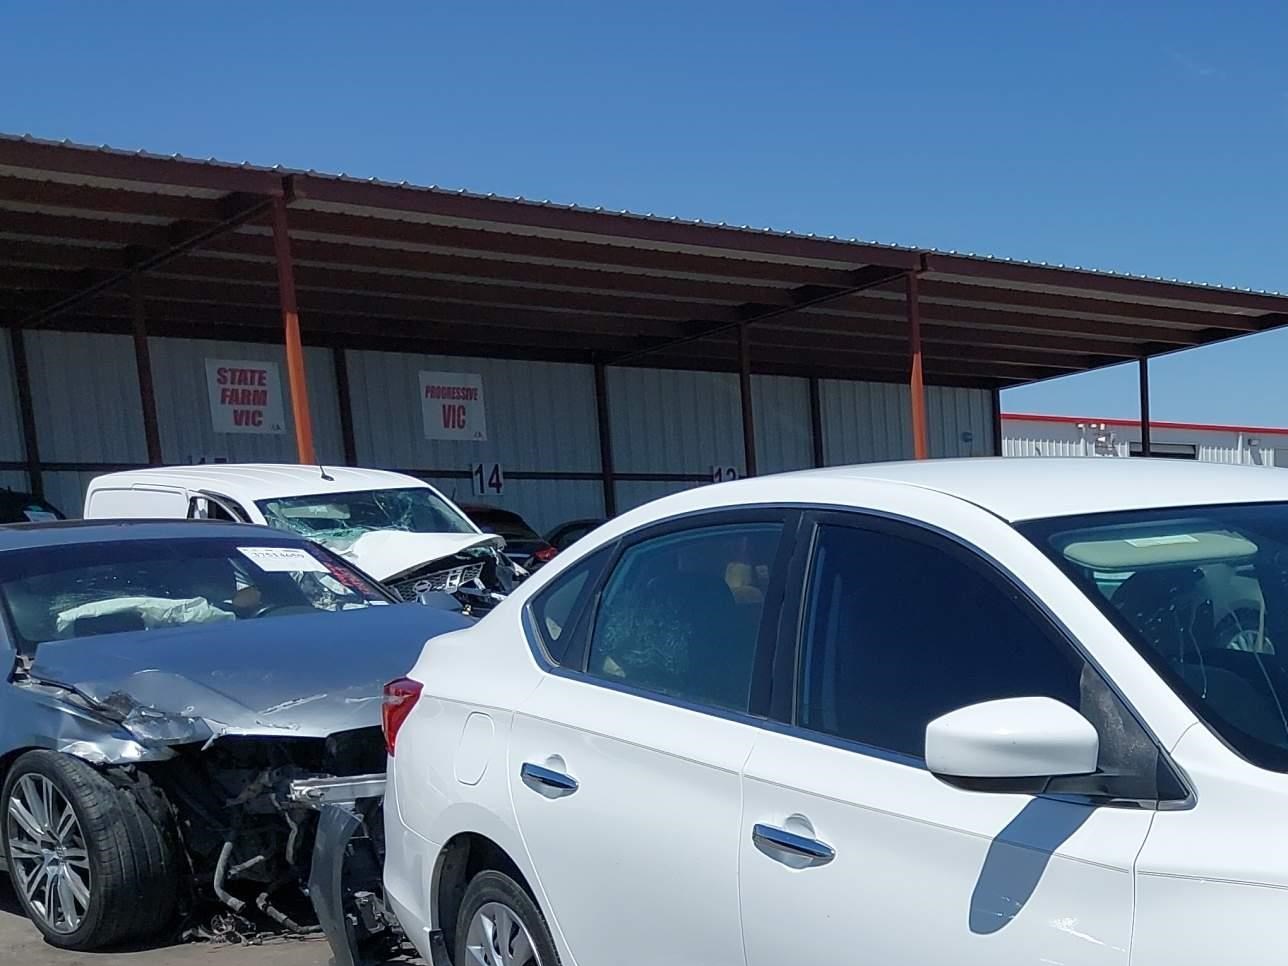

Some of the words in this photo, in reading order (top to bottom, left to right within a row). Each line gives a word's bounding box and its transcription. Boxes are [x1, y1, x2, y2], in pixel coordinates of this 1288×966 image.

[217, 368, 267, 386] STATE
[220, 388, 268, 406] FARM
[425, 385, 479, 401] PROGRESSIVE
[233, 409, 263, 427] VIC
[442, 404, 466, 429] VIC
[474, 463, 502, 494] 14
